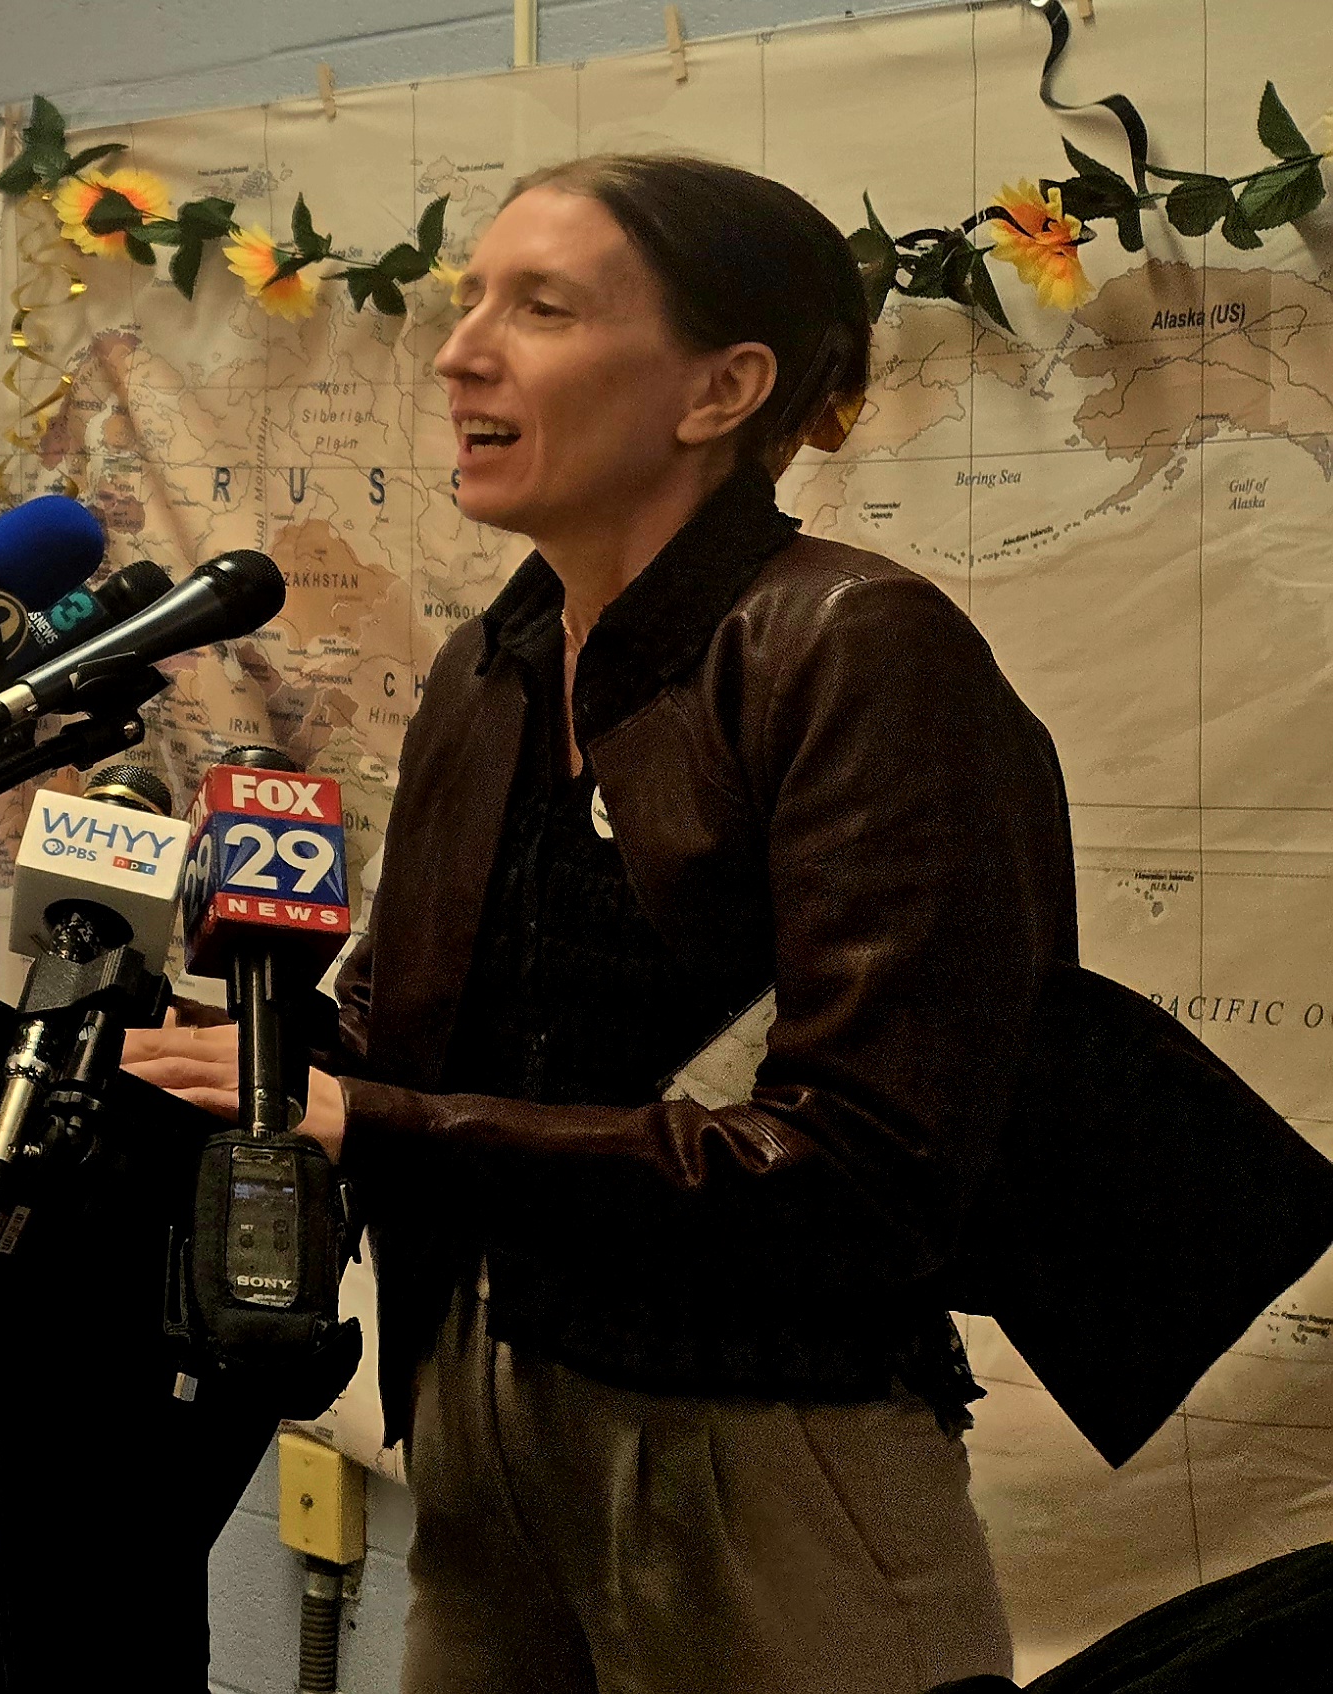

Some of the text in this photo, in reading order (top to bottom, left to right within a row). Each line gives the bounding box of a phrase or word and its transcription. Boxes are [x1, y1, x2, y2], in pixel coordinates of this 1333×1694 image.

[1151, 302, 1245, 330] Alaska (US)
[1038, 354, 1061, 389] Bering
[318, 380, 357, 395] West
[302, 408, 374, 424] Siberian
[315, 435, 358, 449] Plain
[255, 405, 271, 501] Mountains
[954, 469, 1022, 488] Bering Sea
[1229, 478, 1269, 494] Gulf of
[1229, 495, 1266, 510] Alaska
[50, 591, 93, 631] 3
[424, 603, 484, 619] MONGOL
[229, 717, 259, 734] IRAN
[232, 774, 325, 818] FOX
[42, 807, 176, 859] WHYY
[66, 845, 97, 862] PBS
[224, 822, 335, 894] 29
[115, 857, 154, 875] npr
[228, 898, 340, 925] NEWS
[1148, 993, 1285, 1026] PACIFIC
[237, 1275, 292, 1290] SONY
